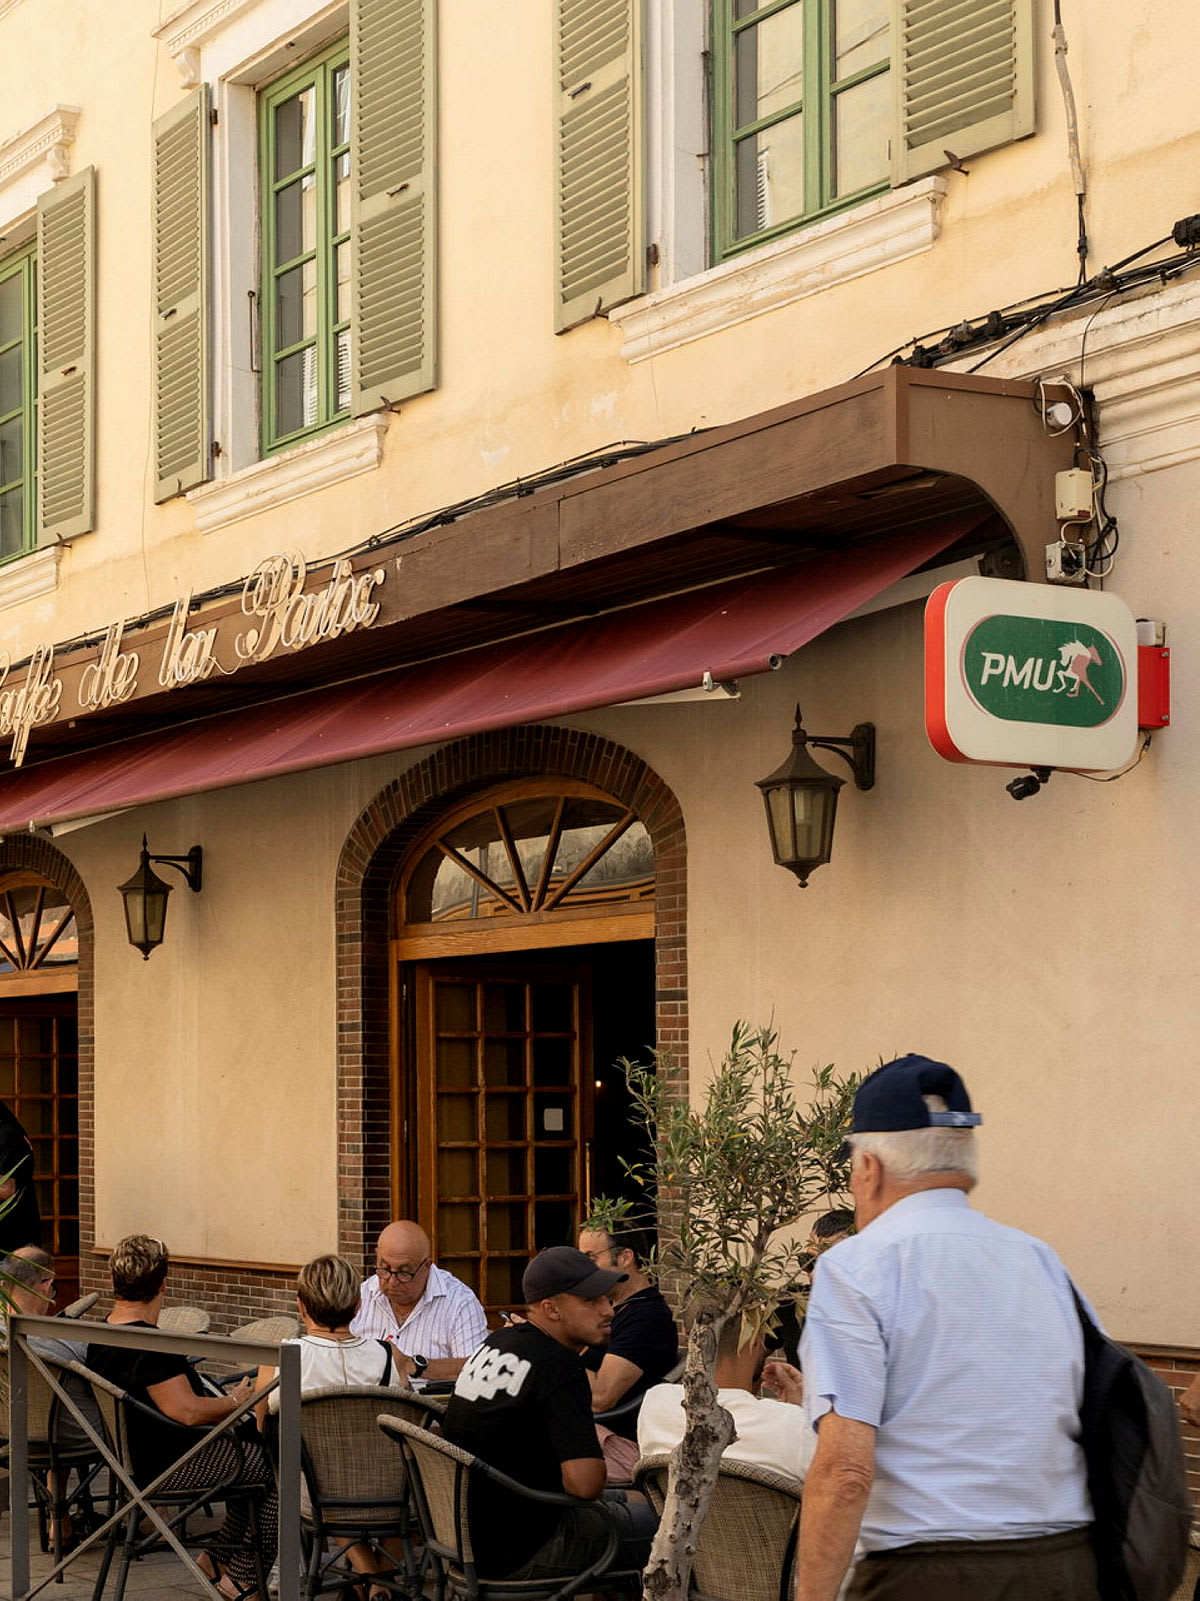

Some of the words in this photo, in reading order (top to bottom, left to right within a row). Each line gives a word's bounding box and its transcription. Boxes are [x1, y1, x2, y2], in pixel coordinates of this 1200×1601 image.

[78, 619, 140, 710] de
[158, 588, 218, 689] la
[980, 652, 1057, 691] PMU
